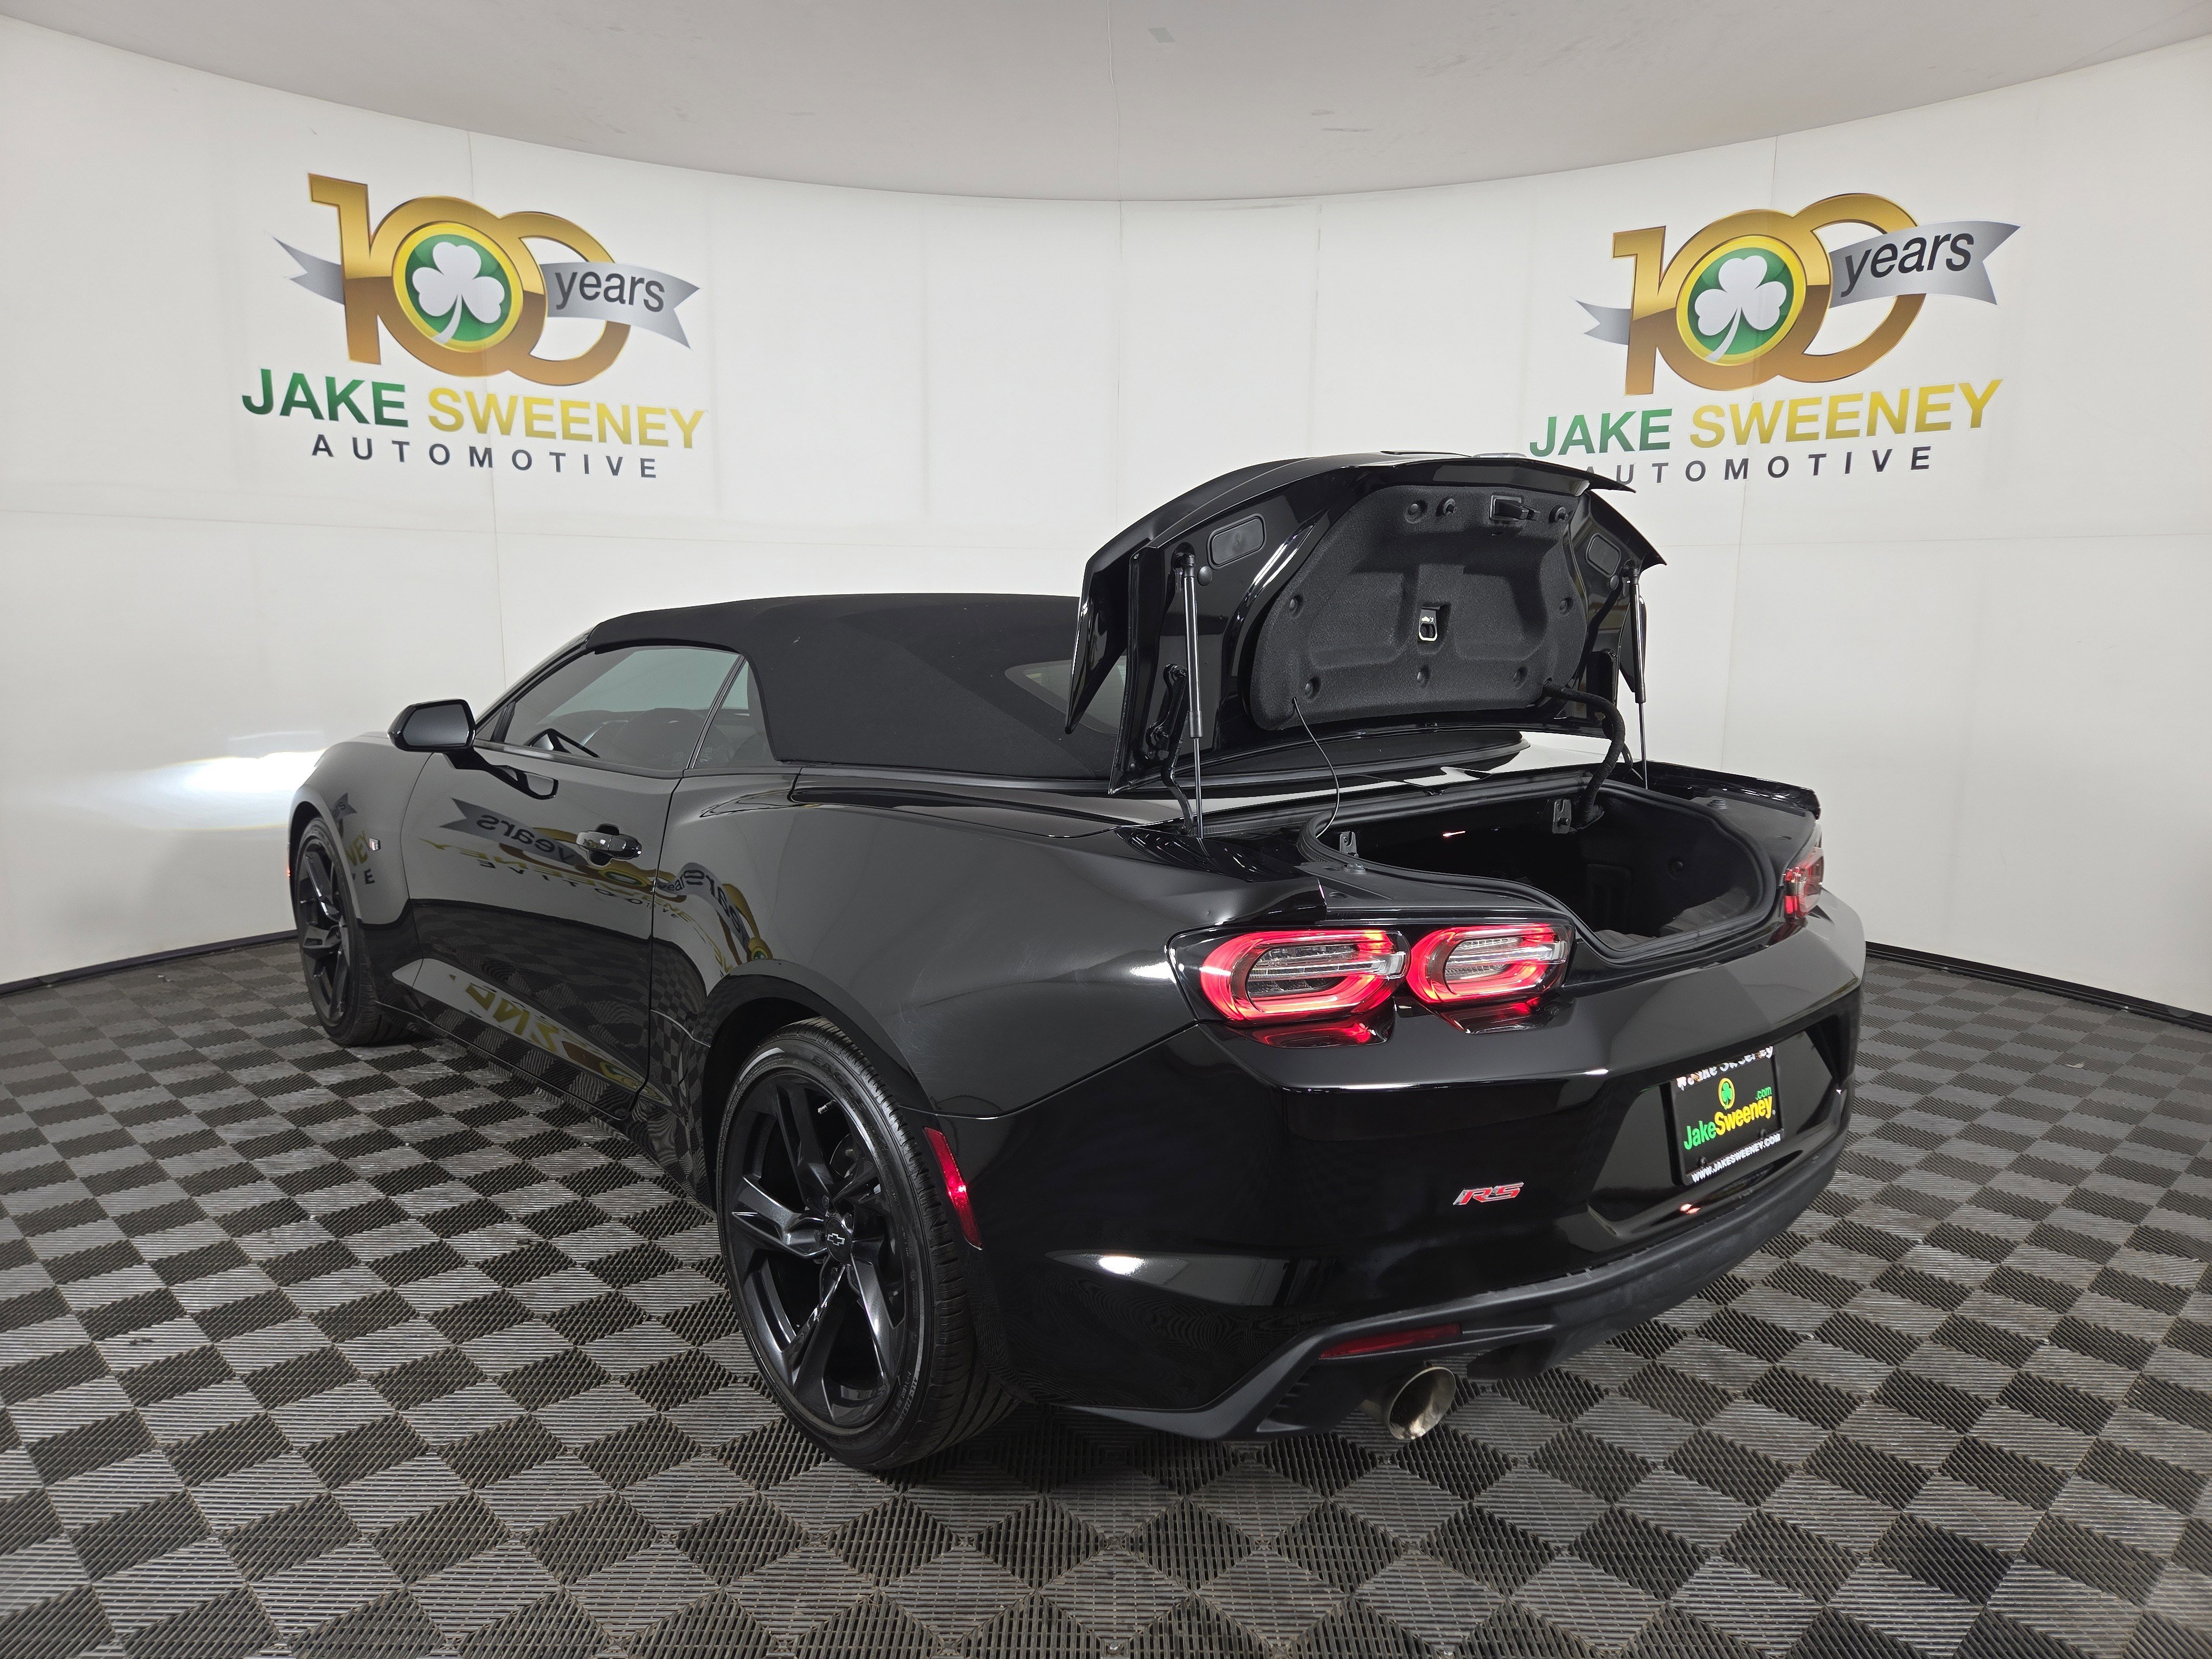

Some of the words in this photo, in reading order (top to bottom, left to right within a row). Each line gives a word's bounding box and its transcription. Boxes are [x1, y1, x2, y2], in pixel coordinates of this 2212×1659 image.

[1841, 232, 1974, 297] years
[554, 269, 665, 313] years
[242, 369, 409, 428] JAKE
[428, 388, 705, 449] SWEENEY
[1529, 409, 1673, 457] JAKE
[1690, 378, 2004, 448] SWEENEY
[312, 434, 657, 478] AUTOMOTIVE
[1755, 1086, 1772, 1101] .com
[1684, 1096, 1772, 1150] JakeSweeney
[1692, 1133, 1781, 1183] WWW.JAKESWEENEY.COM
[1453, 1182, 1524, 1205] RS
